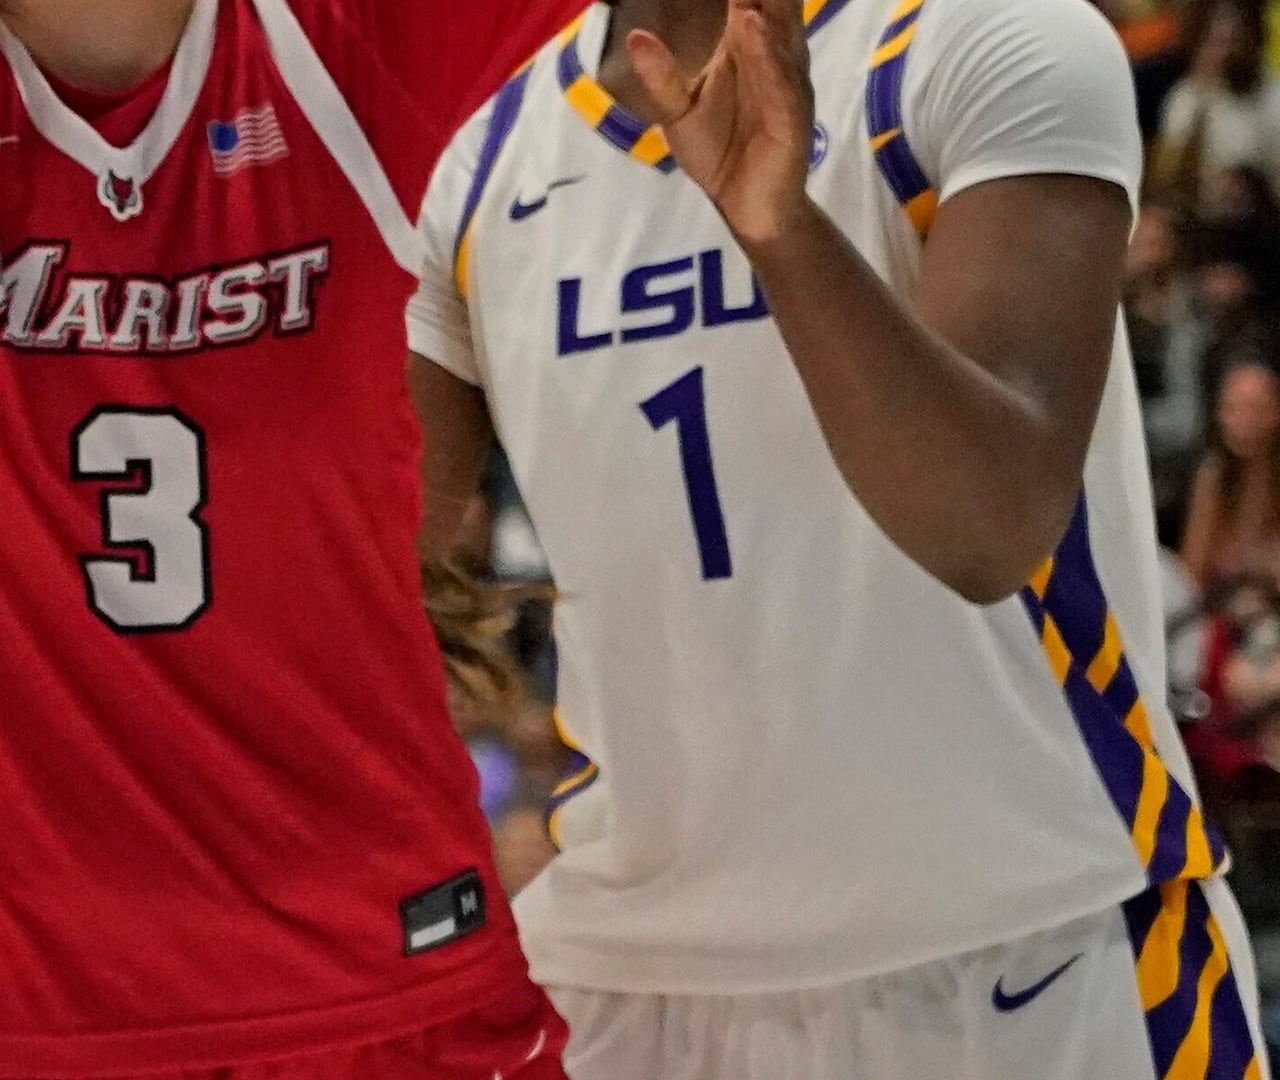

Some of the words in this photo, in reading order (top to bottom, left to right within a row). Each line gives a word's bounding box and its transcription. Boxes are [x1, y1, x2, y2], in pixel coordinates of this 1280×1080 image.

[556, 248, 774, 356] LSU
[70, 403, 212, 635] 3
[637, 365, 733, 581] 1
